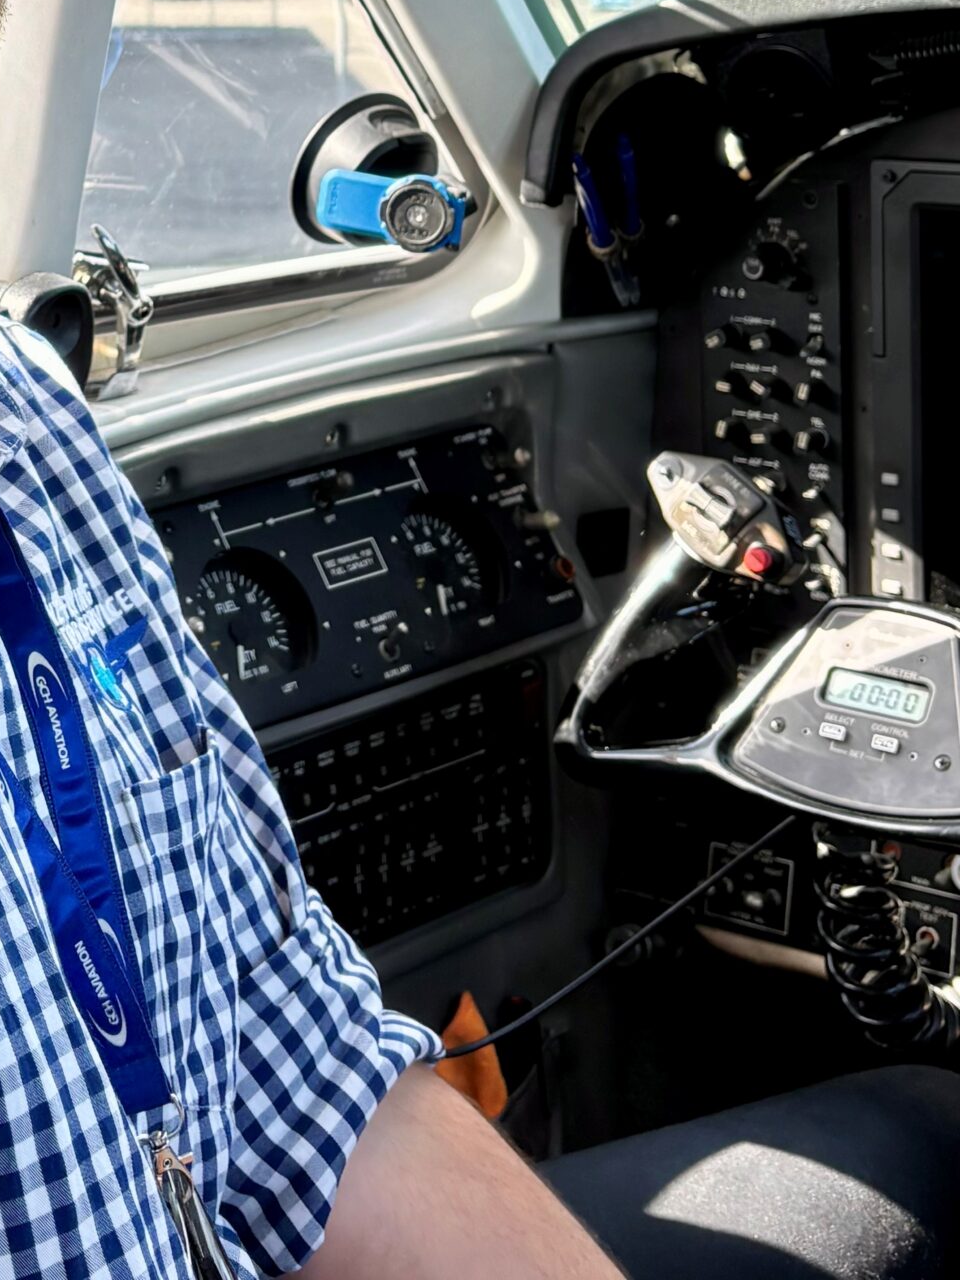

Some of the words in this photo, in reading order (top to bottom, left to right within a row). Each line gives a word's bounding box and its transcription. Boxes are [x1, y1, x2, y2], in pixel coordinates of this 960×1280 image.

[214, 600, 240, 615] FUEL
[849, 682, 920, 714] 00:00
[36, 676, 53, 704] GCH
[46, 705, 71, 770] AVIATION
[824, 712, 855, 726] SELECT
[870, 723, 909, 739] CONTROL
[74, 940, 108, 999] AVIATION
[102, 999, 119, 1026] GCH
